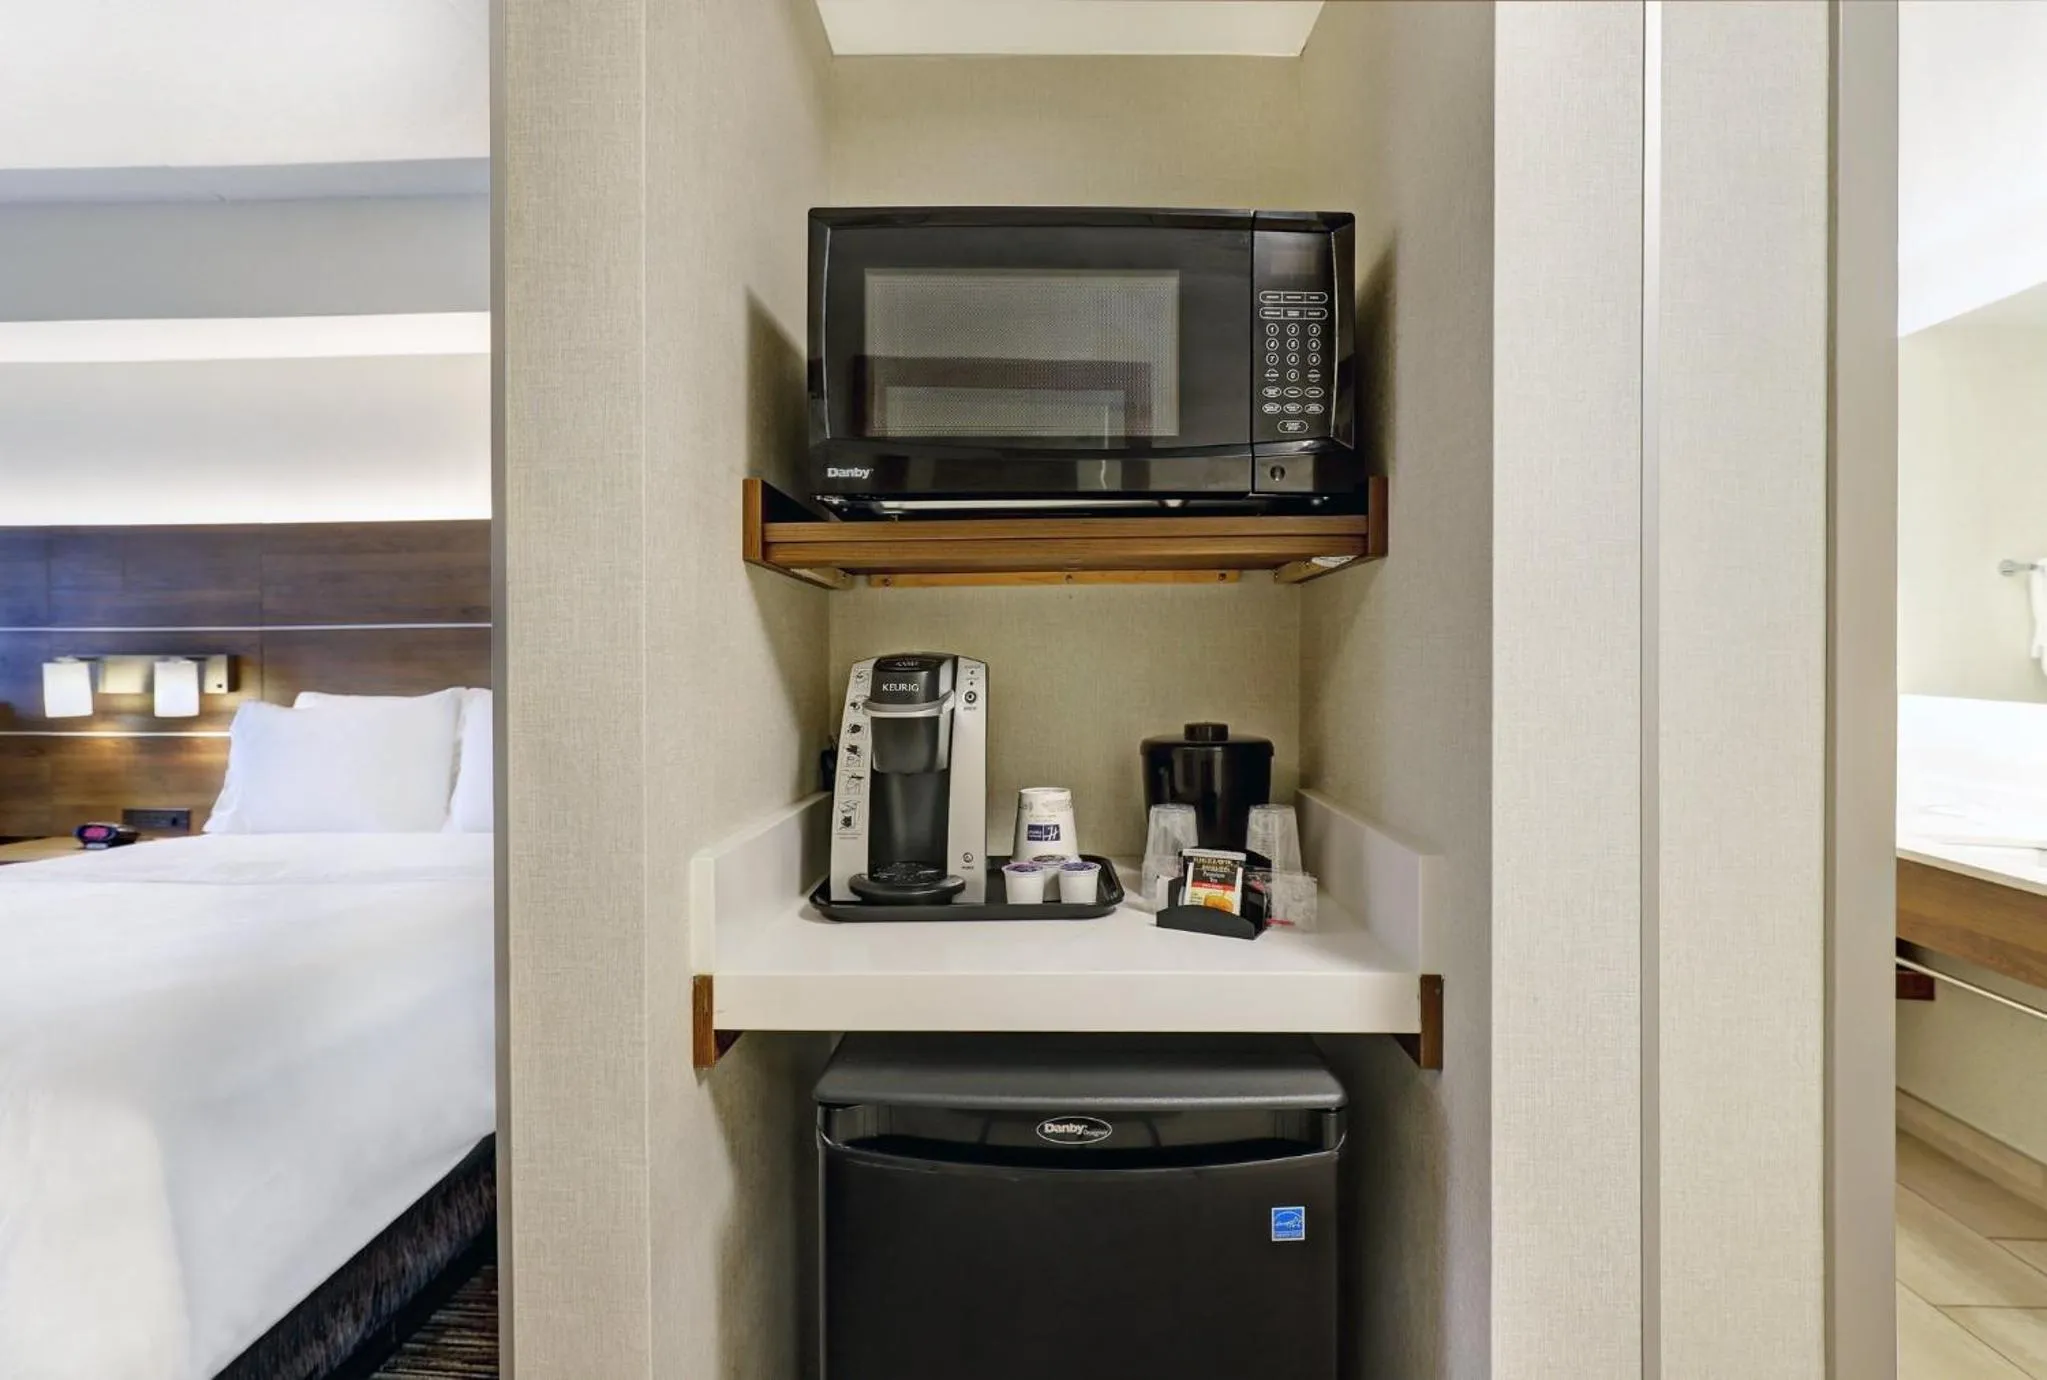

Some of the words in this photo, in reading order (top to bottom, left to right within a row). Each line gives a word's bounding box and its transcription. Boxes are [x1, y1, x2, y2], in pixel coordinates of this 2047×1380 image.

[827, 467, 870, 479] Danby
[882, 683, 919, 692] KEURIG
[1044, 1123, 1088, 1135] Danby
